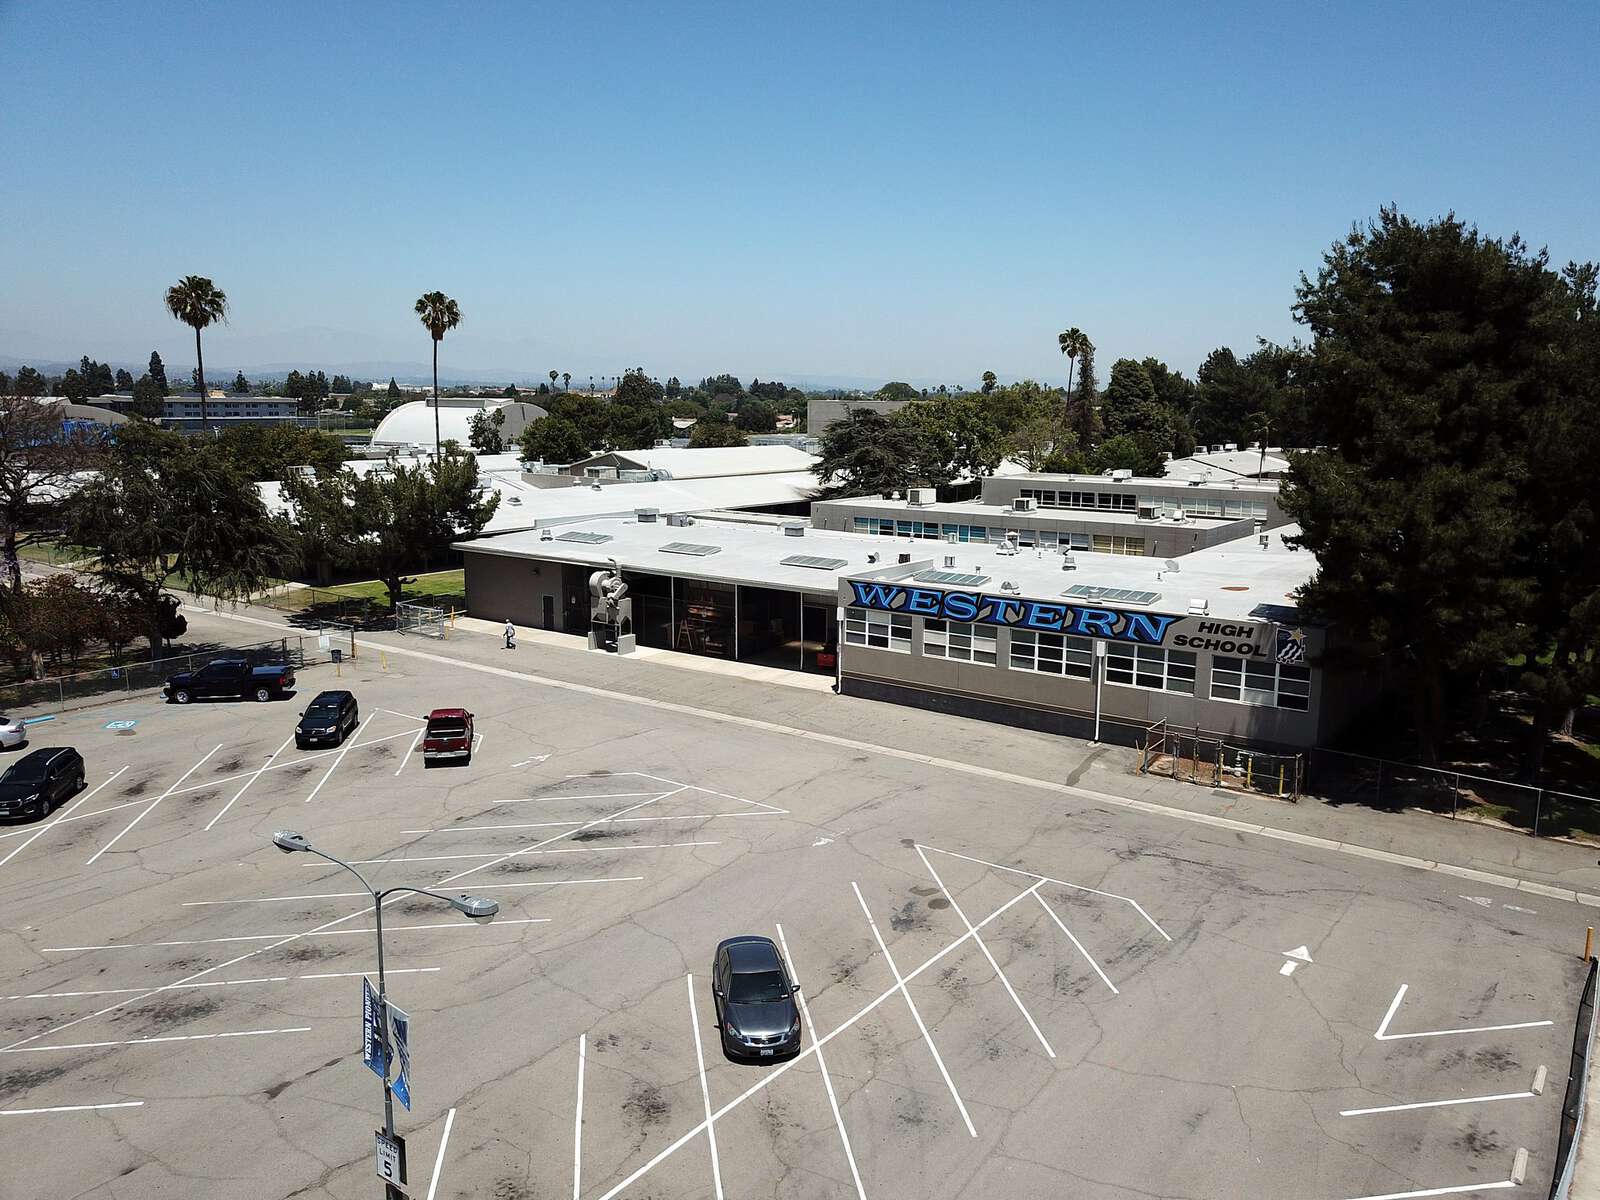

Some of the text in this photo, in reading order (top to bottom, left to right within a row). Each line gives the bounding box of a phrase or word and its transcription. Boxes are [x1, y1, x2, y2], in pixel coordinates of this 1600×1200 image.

[849, 580, 1178, 646] WESTERN
[1198, 621, 1254, 639] HIGH
[1173, 634, 1267, 657] SCHOOL
[364, 1021, 373, 1061] WESTERN
[377, 1136, 398, 1154] SPEED
[379, 1147, 397, 1162] LIMIT
[384, 1160, 392, 1177] 5
